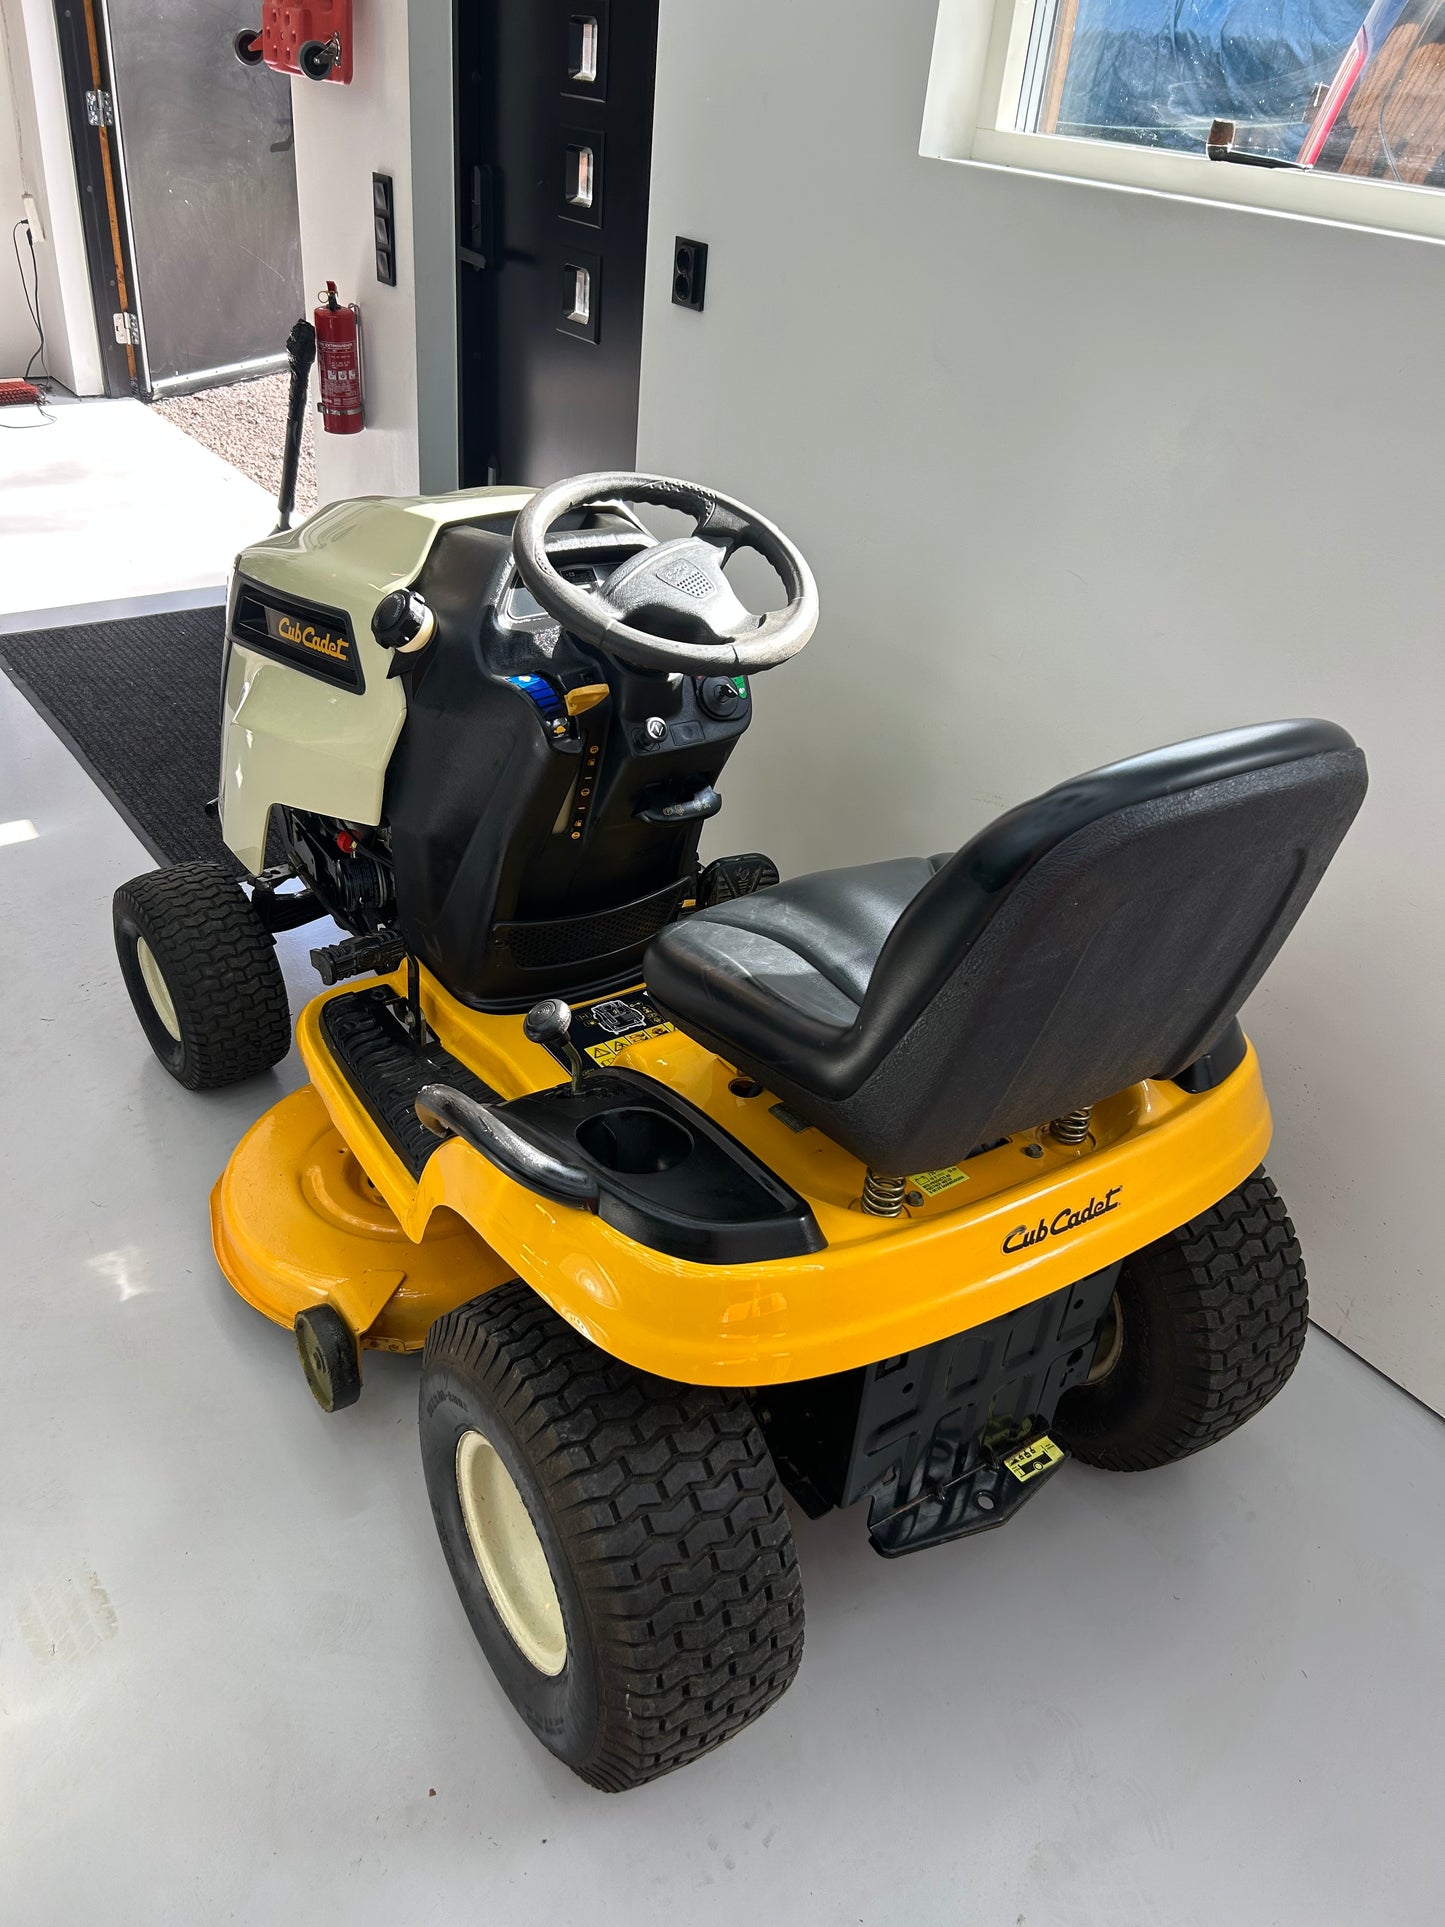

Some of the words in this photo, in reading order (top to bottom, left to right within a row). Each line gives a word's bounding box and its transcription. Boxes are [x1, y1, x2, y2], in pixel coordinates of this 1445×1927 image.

[278, 617, 302, 644] Cub
[302, 626, 350, 661] Cadet
[1002, 1224, 1049, 1254] Cub
[1050, 1186, 1122, 1236] Cadet
